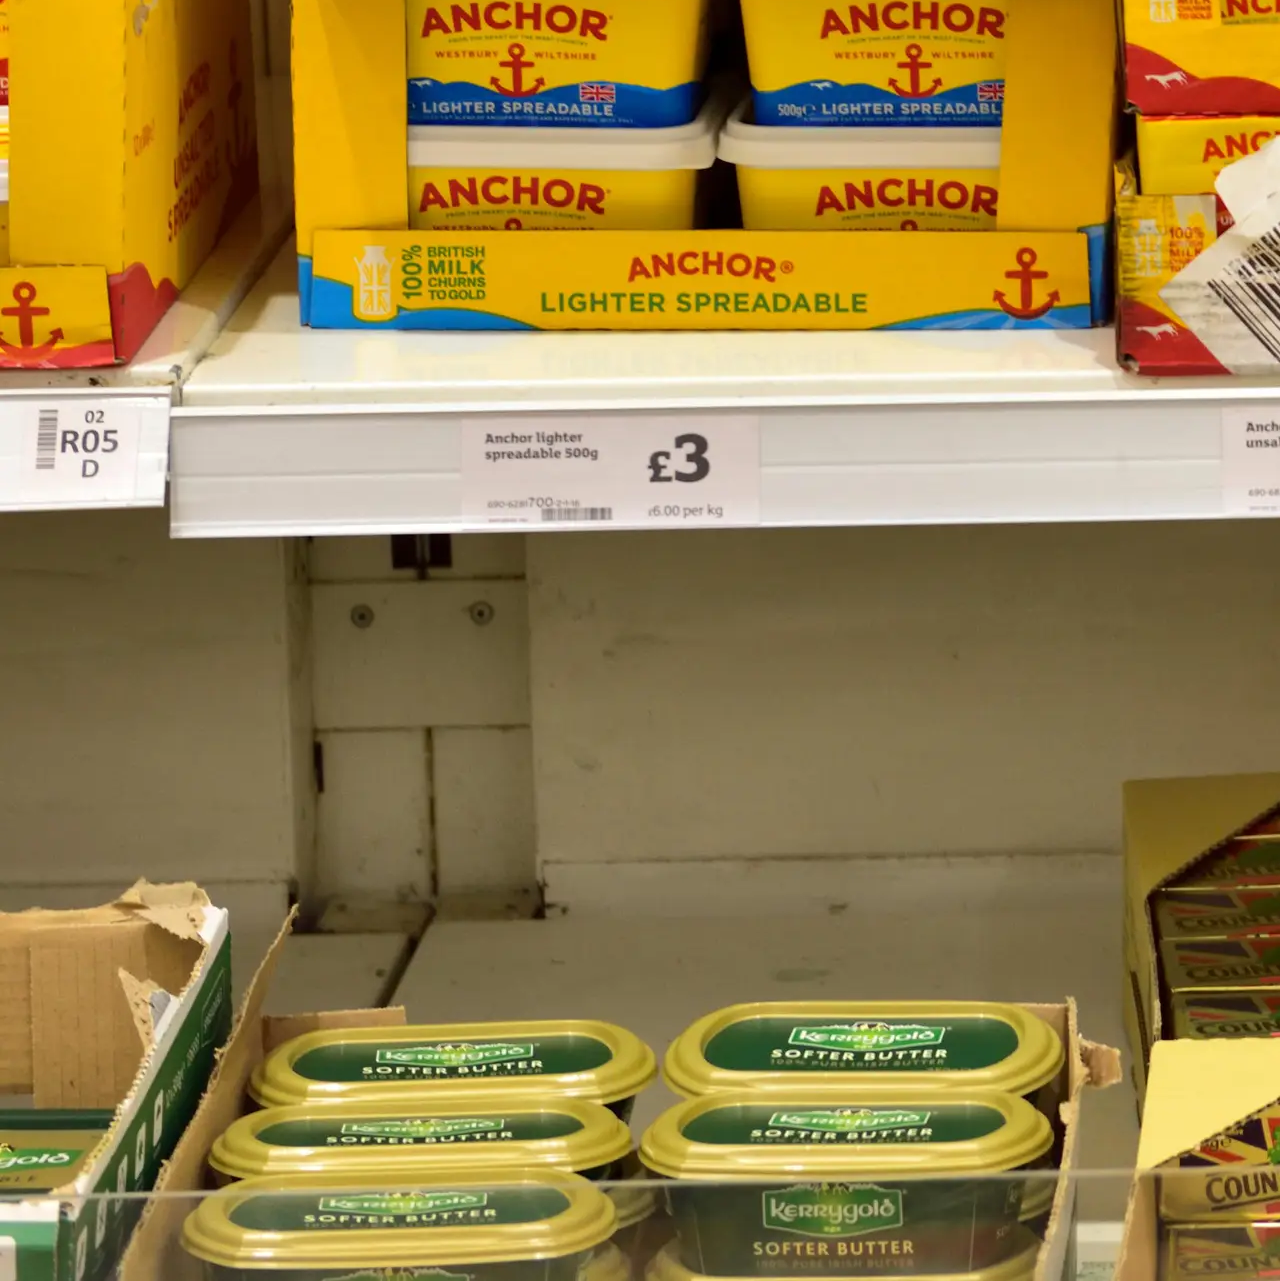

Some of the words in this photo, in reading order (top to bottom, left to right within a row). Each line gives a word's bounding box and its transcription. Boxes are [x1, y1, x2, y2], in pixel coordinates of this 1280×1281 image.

[421, 2, 607, 39] ANCHOR
[540, 292, 667, 314] LIGHTER
[677, 292, 868, 314] SPREADABLE
[84, 410, 105, 424] 02
[60, 430, 119, 454] R05
[484, 432, 535, 445] Anchor
[540, 430, 583, 447] lighter
[485, 448, 561, 461] spreadable
[565, 447, 598, 460] 500g
[647, 434, 711, 483] £3
[82, 459, 99, 478] D
[683, 505, 702, 520] per
[706, 503, 723, 519] kg
[771, 1049, 851, 1060] SOFTER
[863, 1049, 947, 1061] BUTTER
[753, 1243, 832, 1254] SOFTER
[840, 1242, 915, 1254] BUTTER
